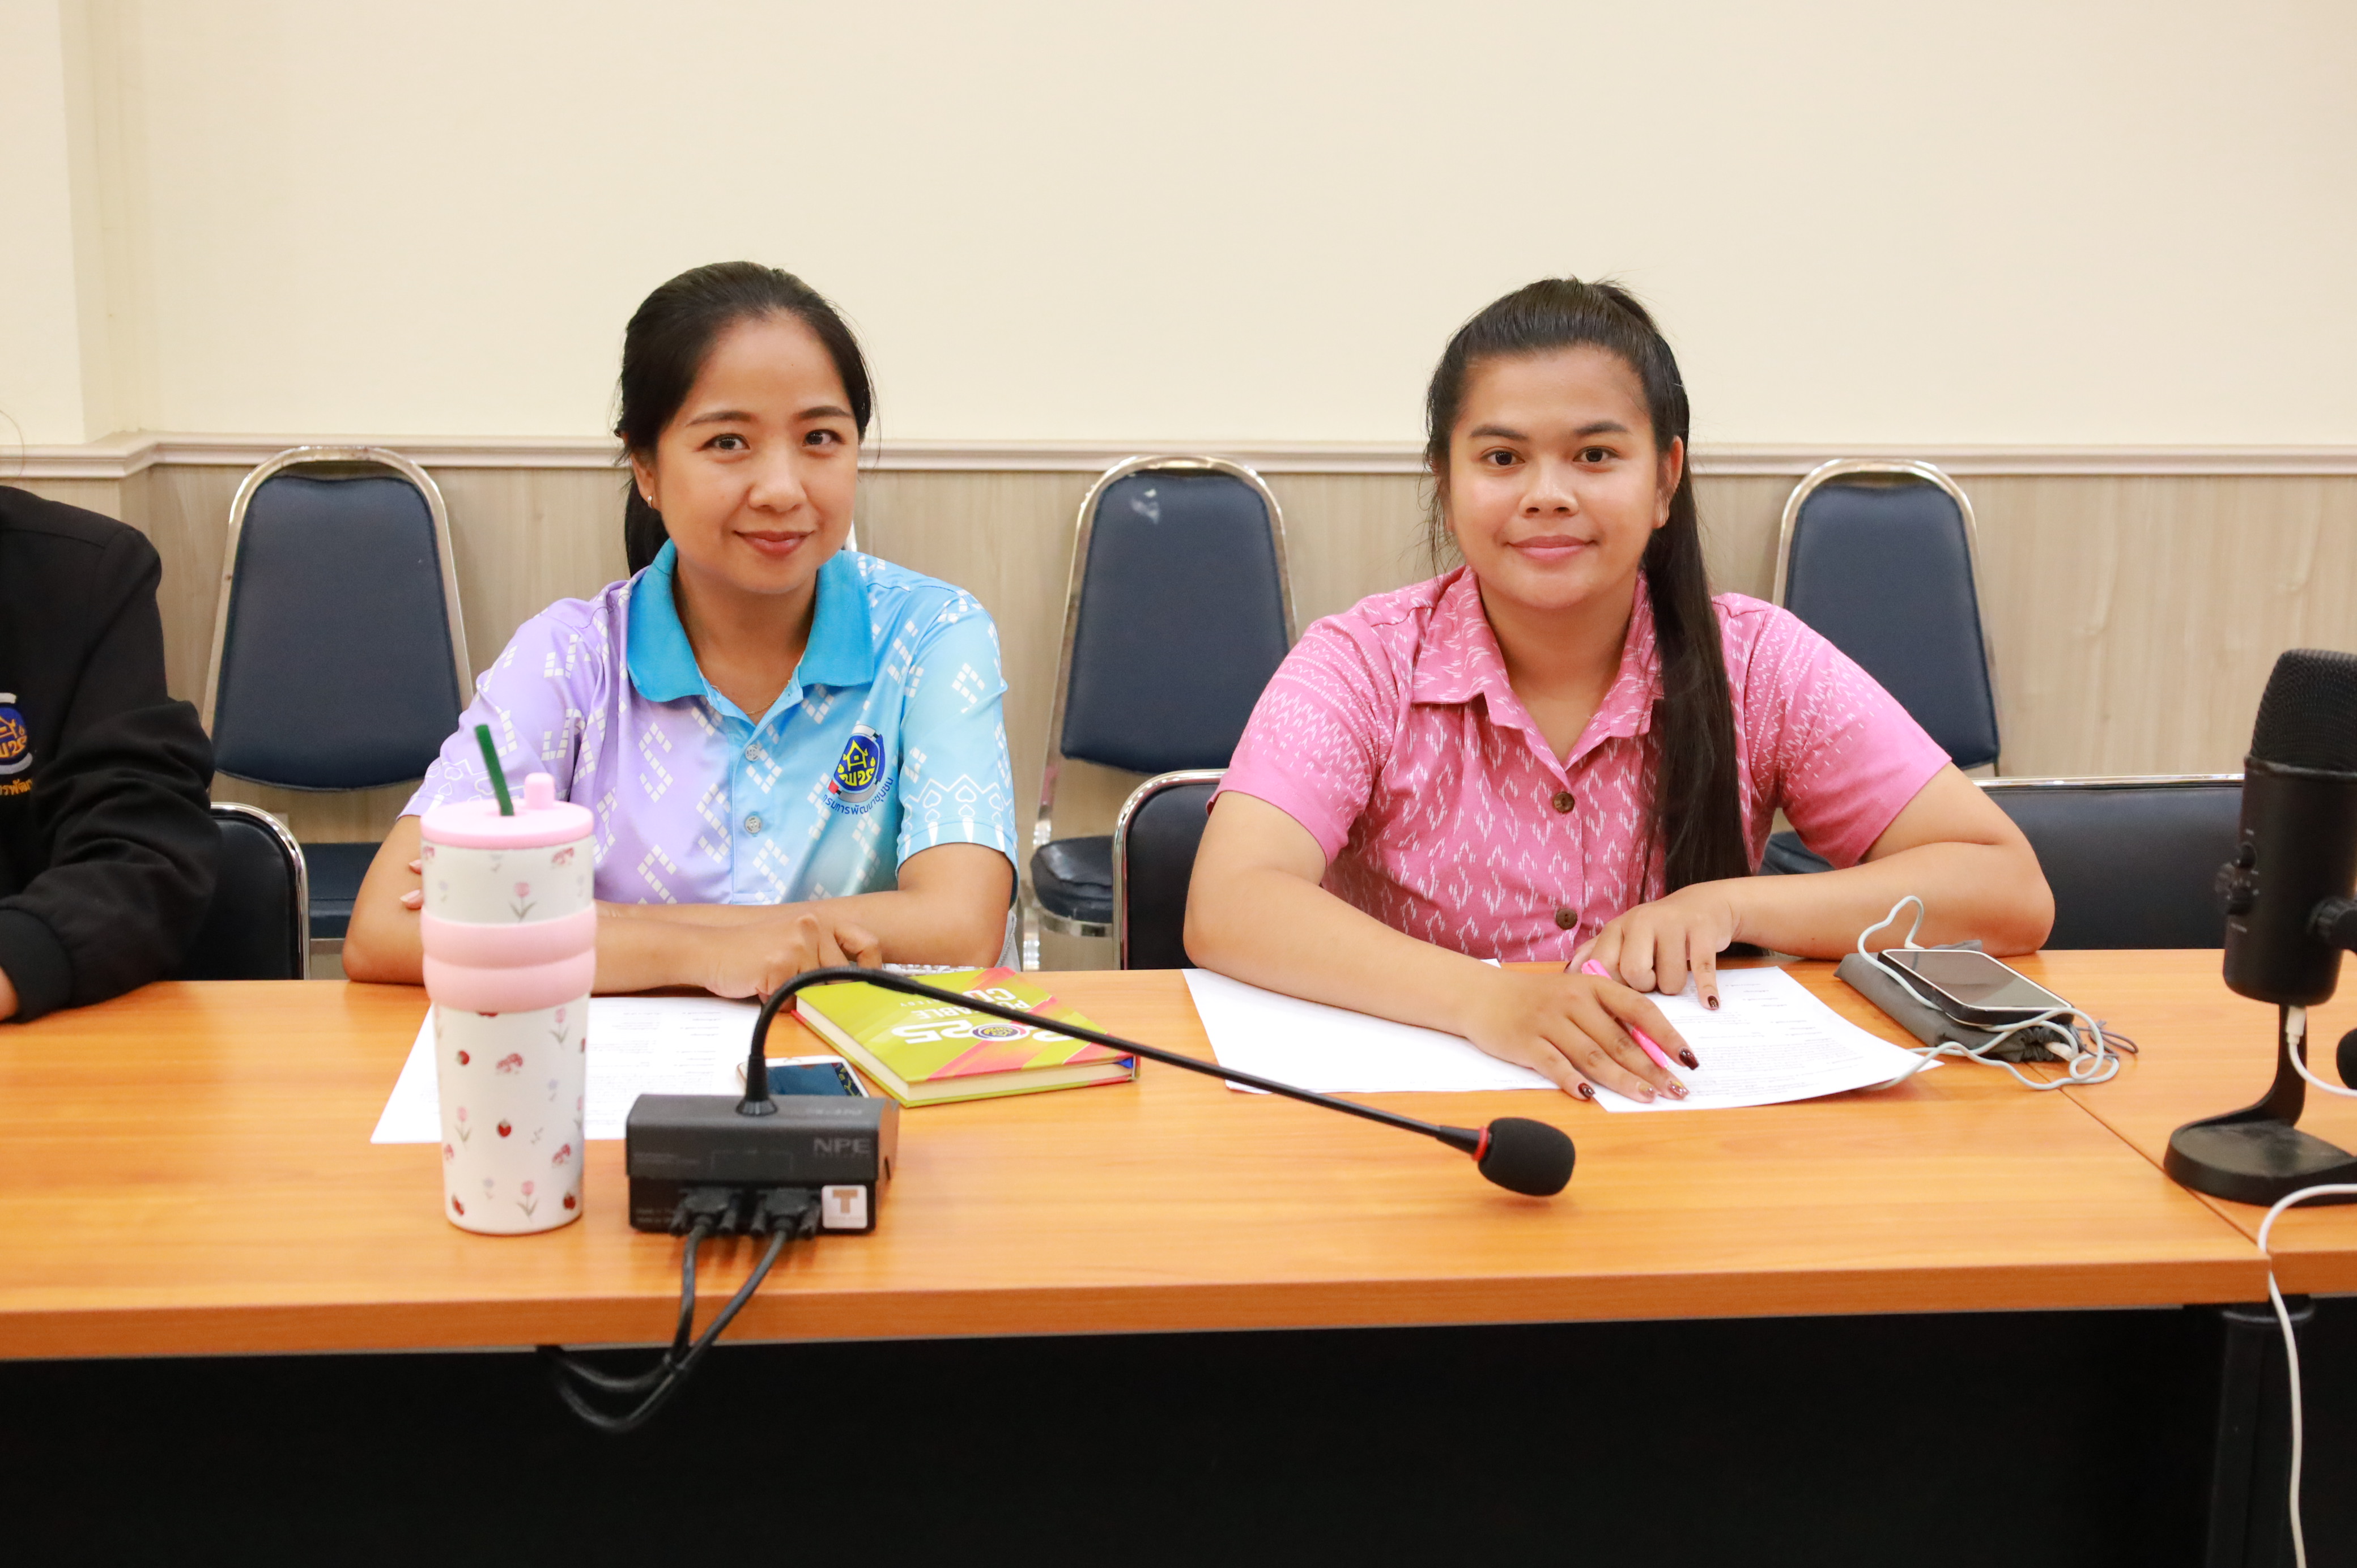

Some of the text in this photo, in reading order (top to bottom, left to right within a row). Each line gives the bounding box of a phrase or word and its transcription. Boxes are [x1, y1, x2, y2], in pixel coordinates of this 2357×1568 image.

[823, 777, 894, 815] กรมการพัฒนาชุมชน
[911, 999, 1031, 1019] POABLE
[814, 1137, 871, 1153] NPE
[832, 1190, 858, 1213] T
